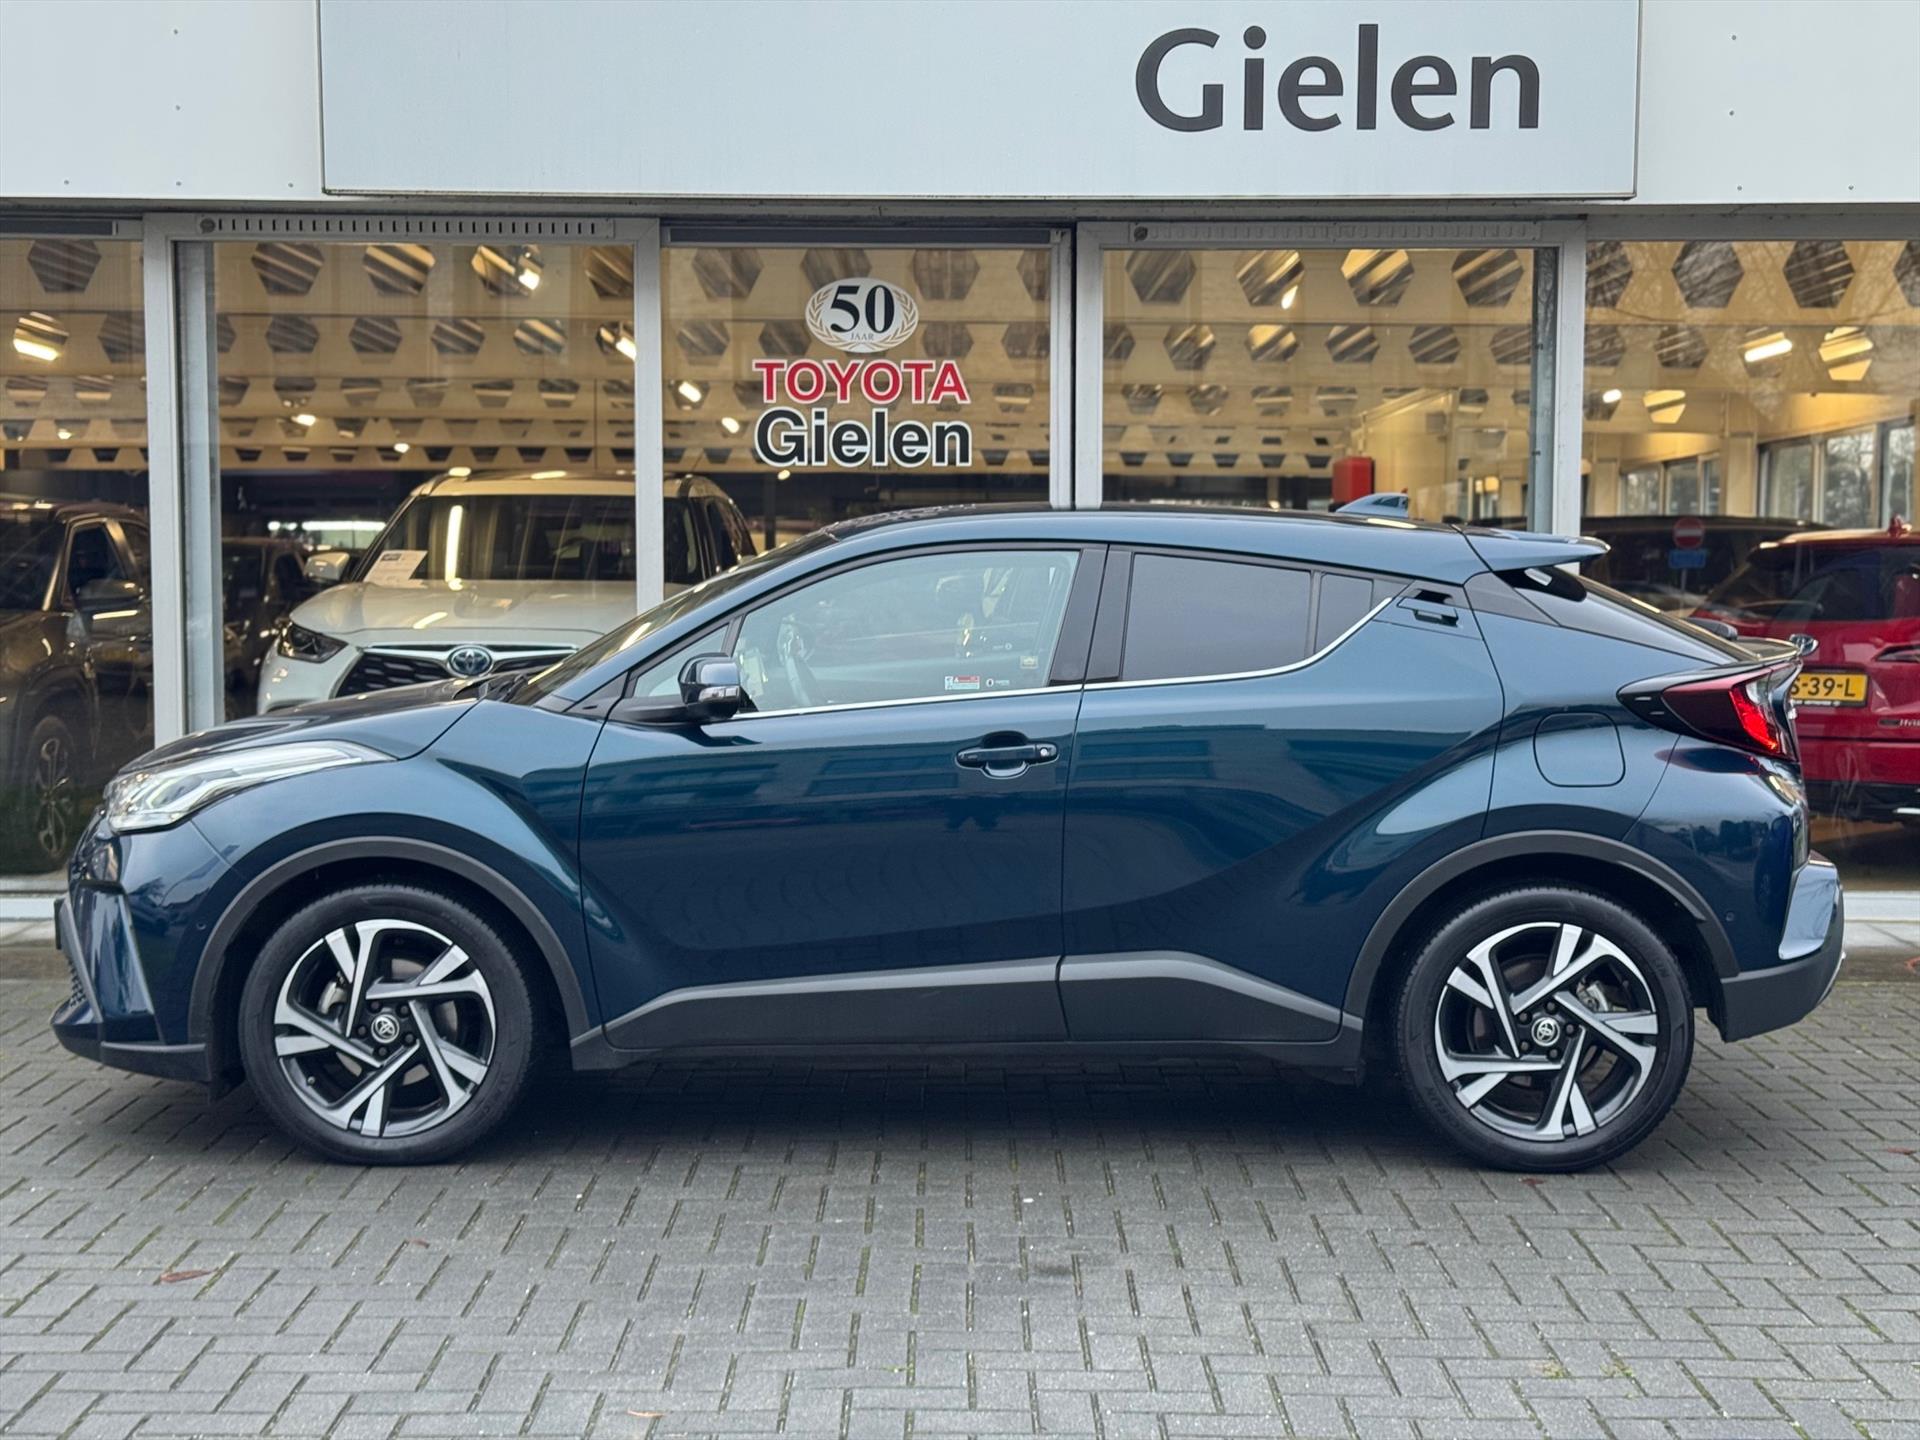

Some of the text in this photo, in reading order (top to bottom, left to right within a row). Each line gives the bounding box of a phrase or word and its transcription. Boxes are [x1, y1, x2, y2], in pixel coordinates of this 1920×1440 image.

[1135, 23, 1540, 132] Gielen
[829, 284, 895, 334] 50
[850, 332, 874, 341] JAAR
[753, 360, 971, 403] TOYOTA
[755, 407, 972, 467] Gielen
